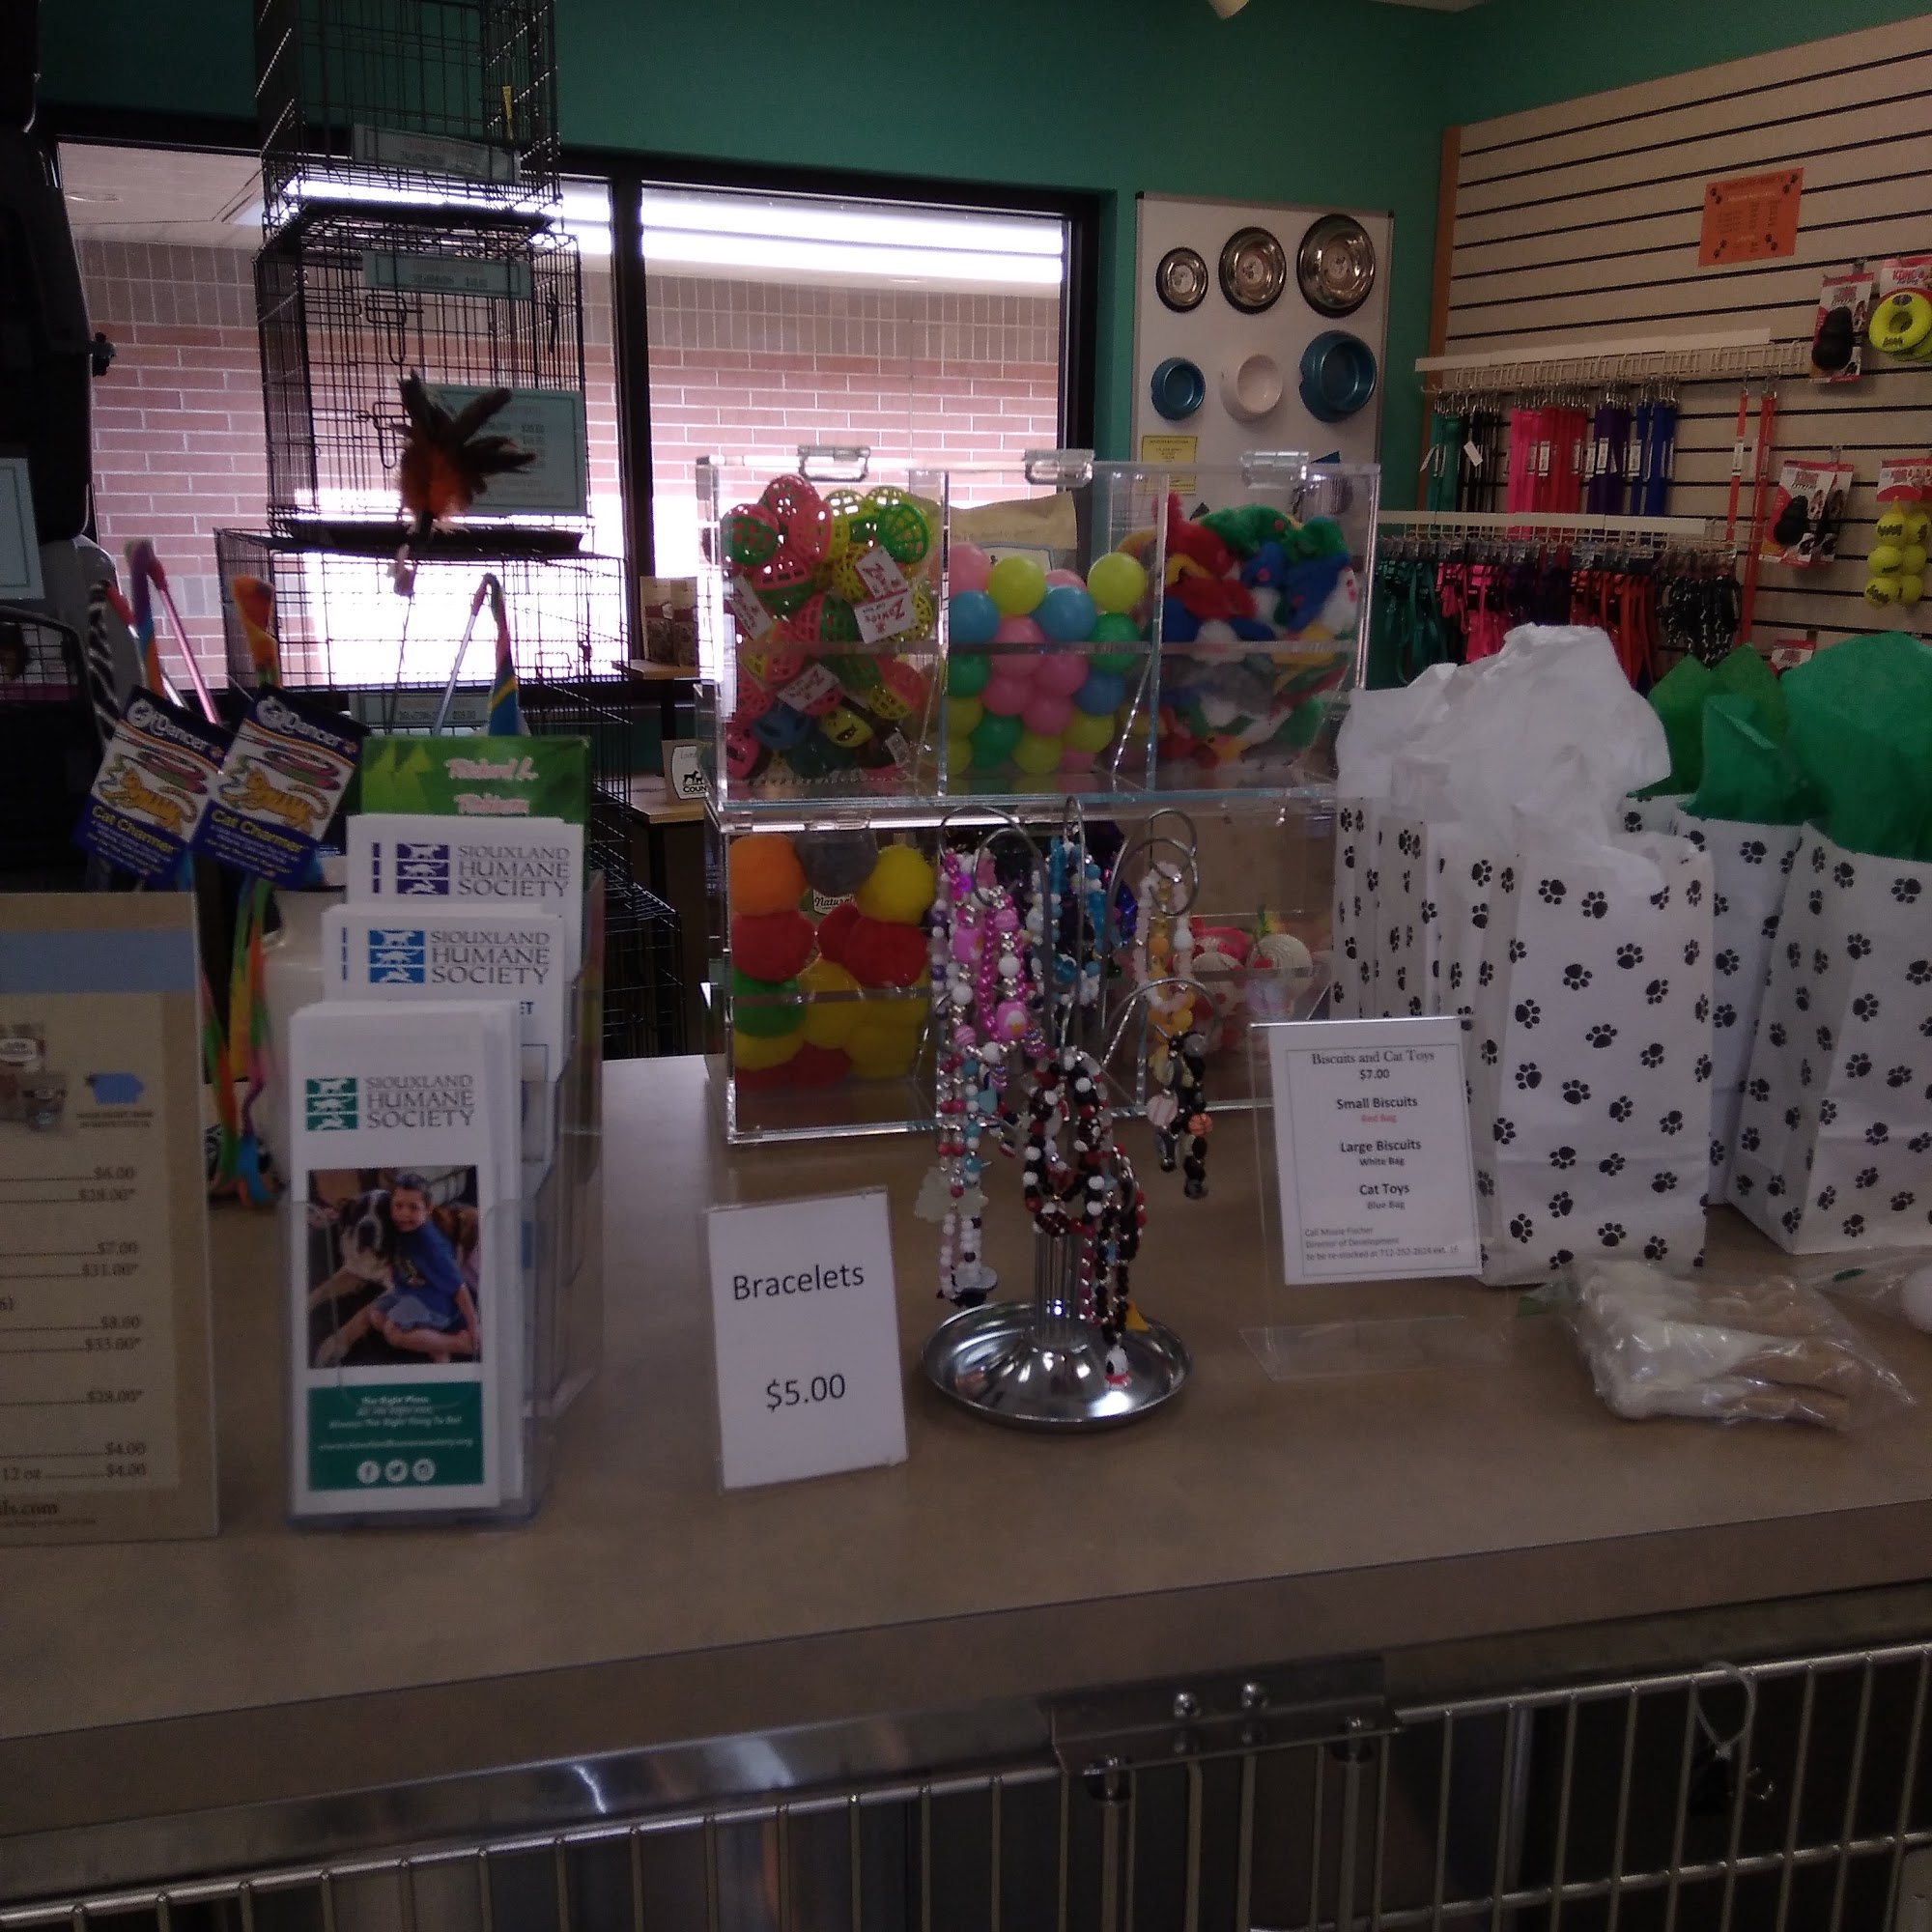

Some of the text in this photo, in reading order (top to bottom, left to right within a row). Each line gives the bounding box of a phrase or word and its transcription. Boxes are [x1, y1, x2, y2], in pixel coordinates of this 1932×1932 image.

[116, 818, 178, 854] Charmer
[212, 809, 241, 829] Cat
[241, 821, 302, 854] Charmer
[458, 844, 571, 861] SIOUXLAND
[458, 861, 572, 879] HUMANE
[457, 879, 570, 897] SOCIETY
[430, 930, 551, 946] SIOUXLAND
[431, 948, 551, 965] HUMANE
[431, 966, 550, 984] SOCIETY
[1312, 1049, 1435, 1065] Biscuits and Cat Toys
[365, 1074, 473, 1089] SIOUXLAND
[1360, 1067, 1390, 1081] $7.00
[366, 1091, 475, 1108] HUMANE
[1337, 1095, 1418, 1110] Small Biscuits
[366, 1110, 475, 1128] SOCIETY
[1341, 1138, 1422, 1153] Large Biscuits
[1360, 1156, 1406, 1167] White Bag
[1360, 1182, 1410, 1196] Cat Toys
[1367, 1200, 1406, 1211] Blue Bag
[733, 1264, 865, 1300] Bracelets
[766, 1373, 845, 1413] $5.00
